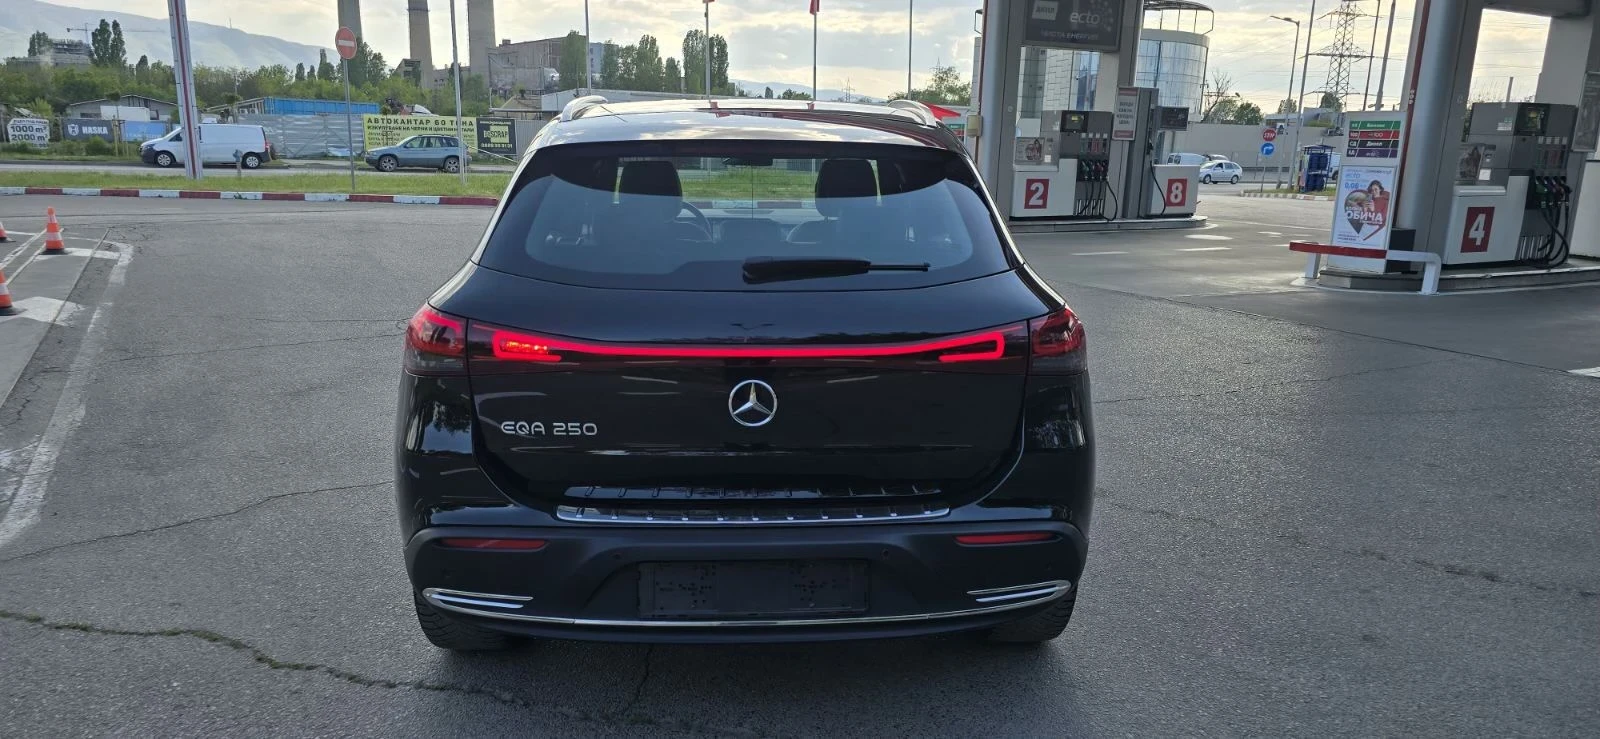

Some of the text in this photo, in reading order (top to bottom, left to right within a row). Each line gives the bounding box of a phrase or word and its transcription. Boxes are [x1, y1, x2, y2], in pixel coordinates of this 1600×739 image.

[1070, 11, 1100, 24] ecto
[367, 117, 431, 126] АВТОКАНТАР
[11, 125, 34, 133] 1000
[82, 126, 108, 135] HASKA
[1028, 182, 1045, 206] 2
[1170, 182, 1183, 204] 8
[1345, 210, 1383, 222] ОБИЧА
[1468, 213, 1486, 246] 4
[501, 421, 598, 436] EQA 250
